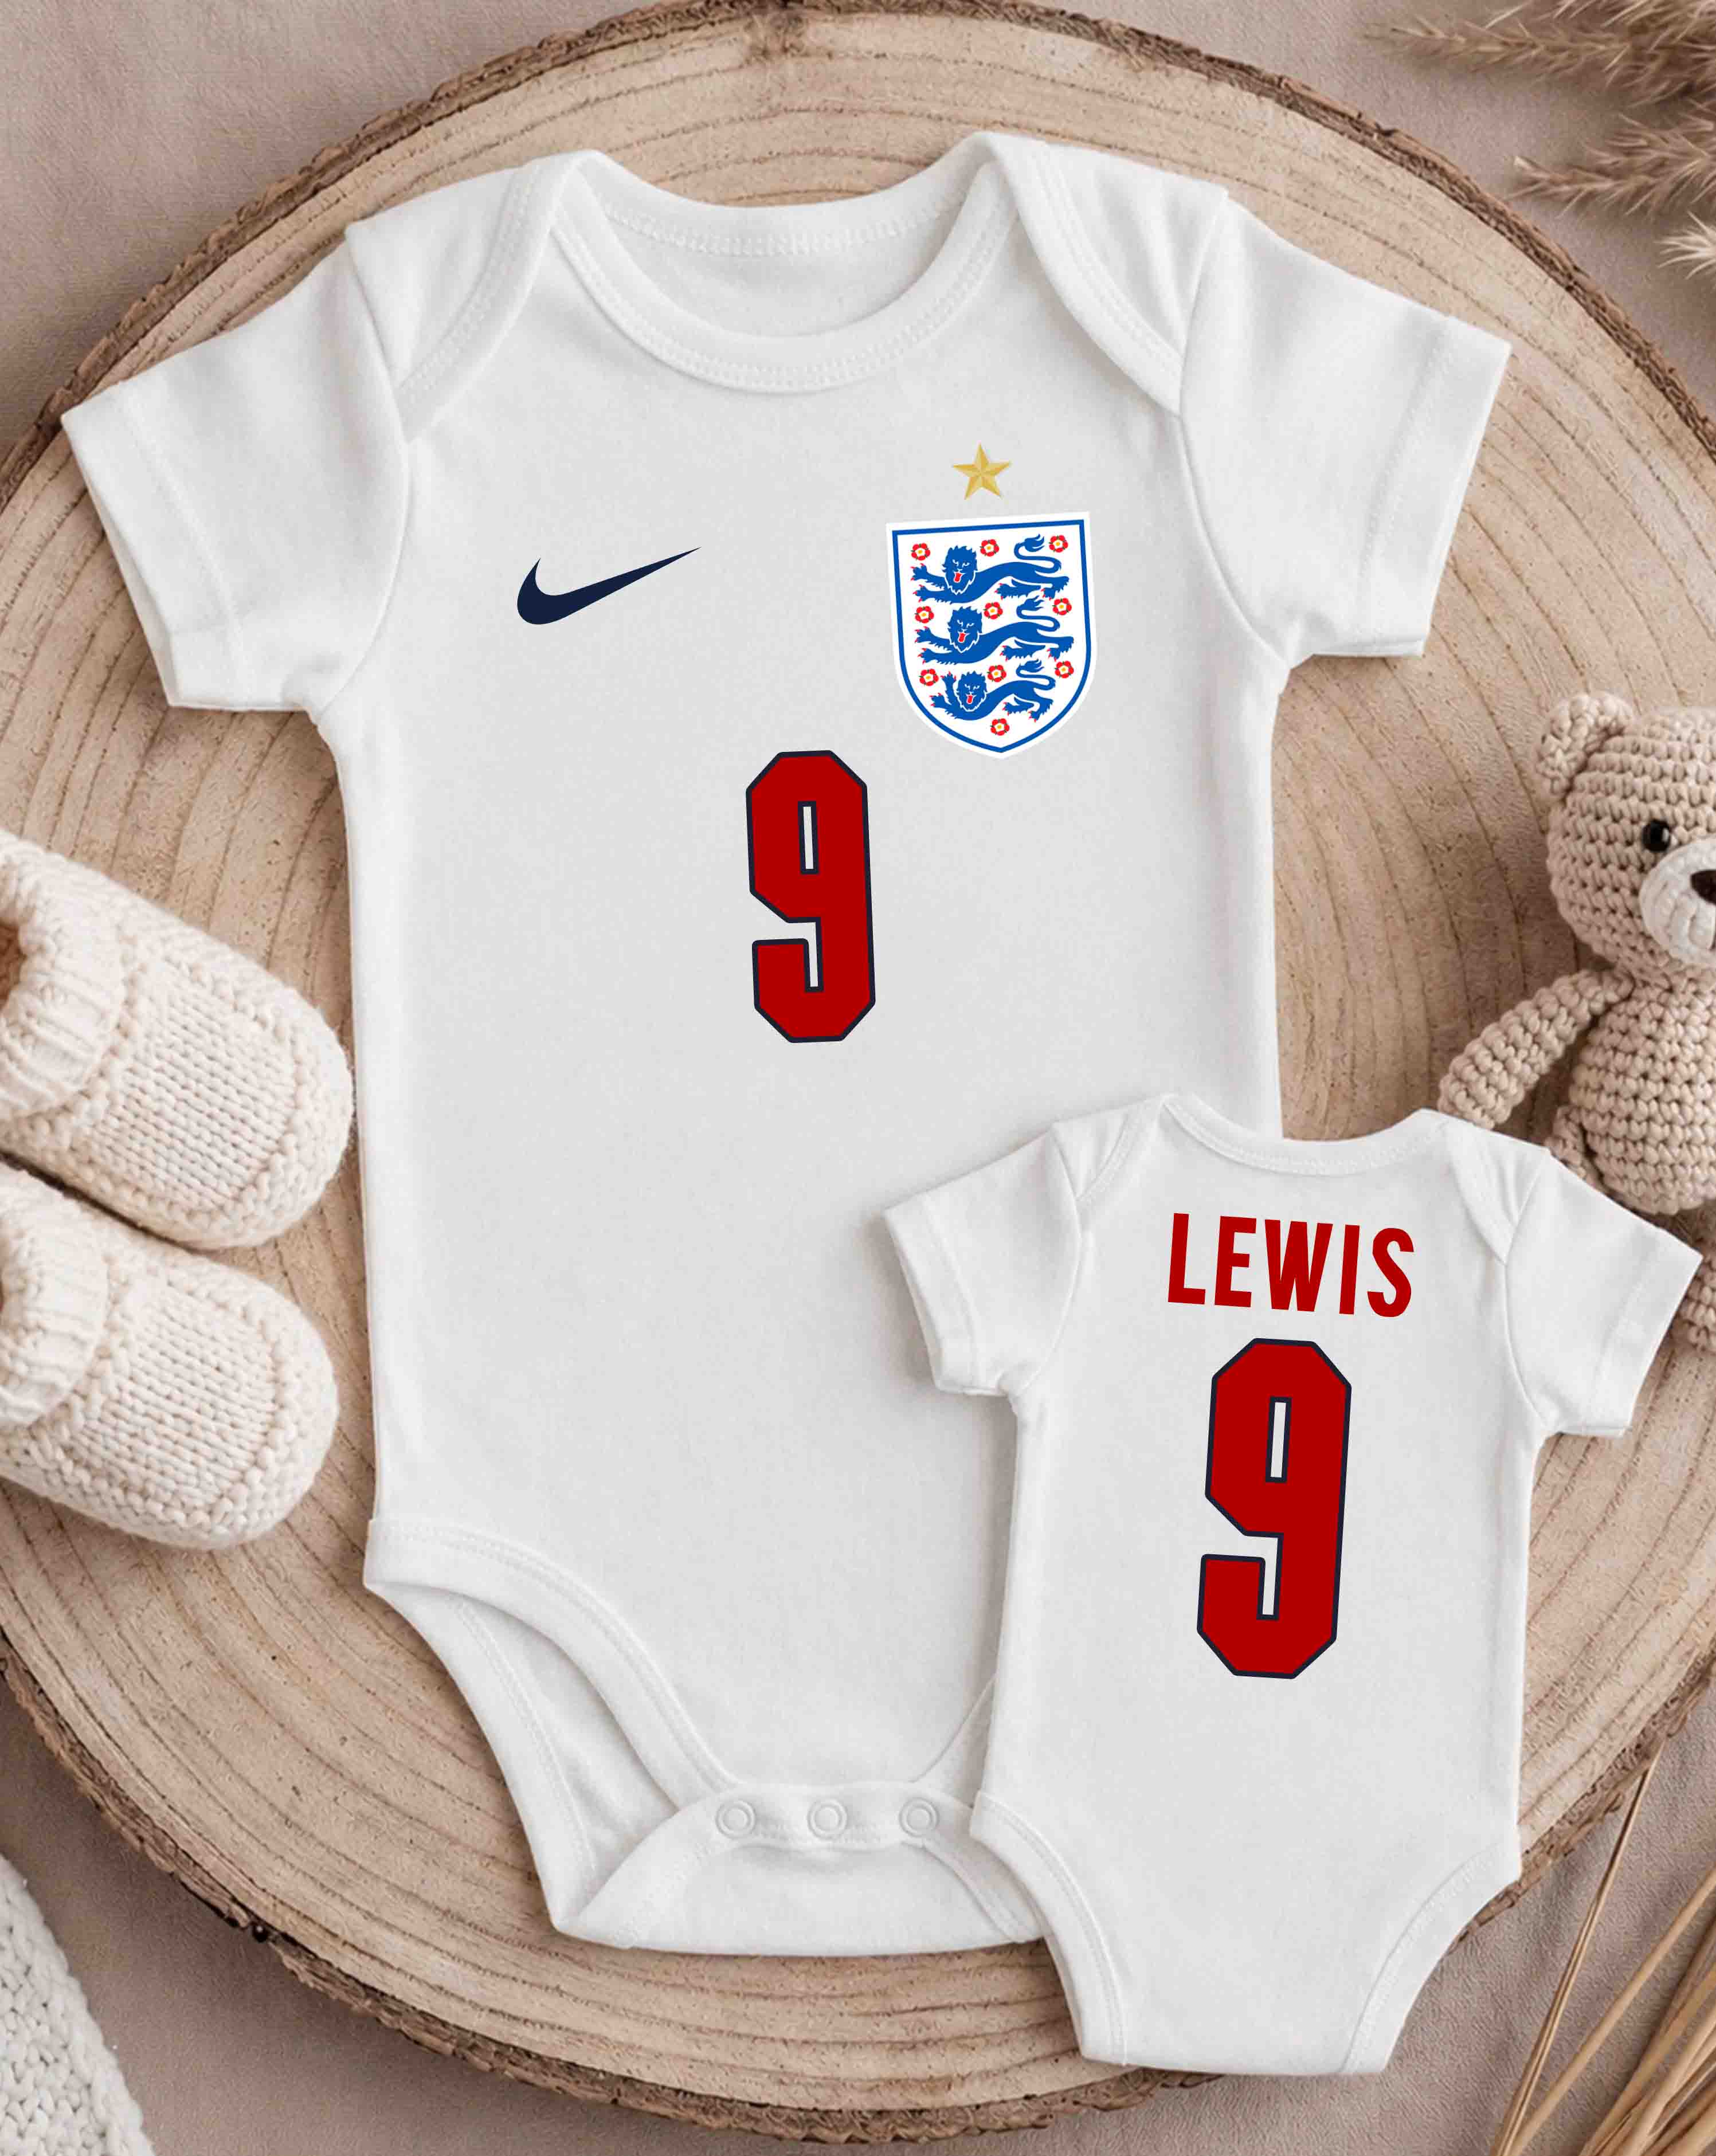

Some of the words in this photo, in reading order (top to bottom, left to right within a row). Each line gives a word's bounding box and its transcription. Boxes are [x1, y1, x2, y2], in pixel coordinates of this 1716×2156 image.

[746, 750, 875, 1043] 9
[1168, 1213, 1414, 1318] LEWIS
[1197, 1338, 1352, 1679] 9
